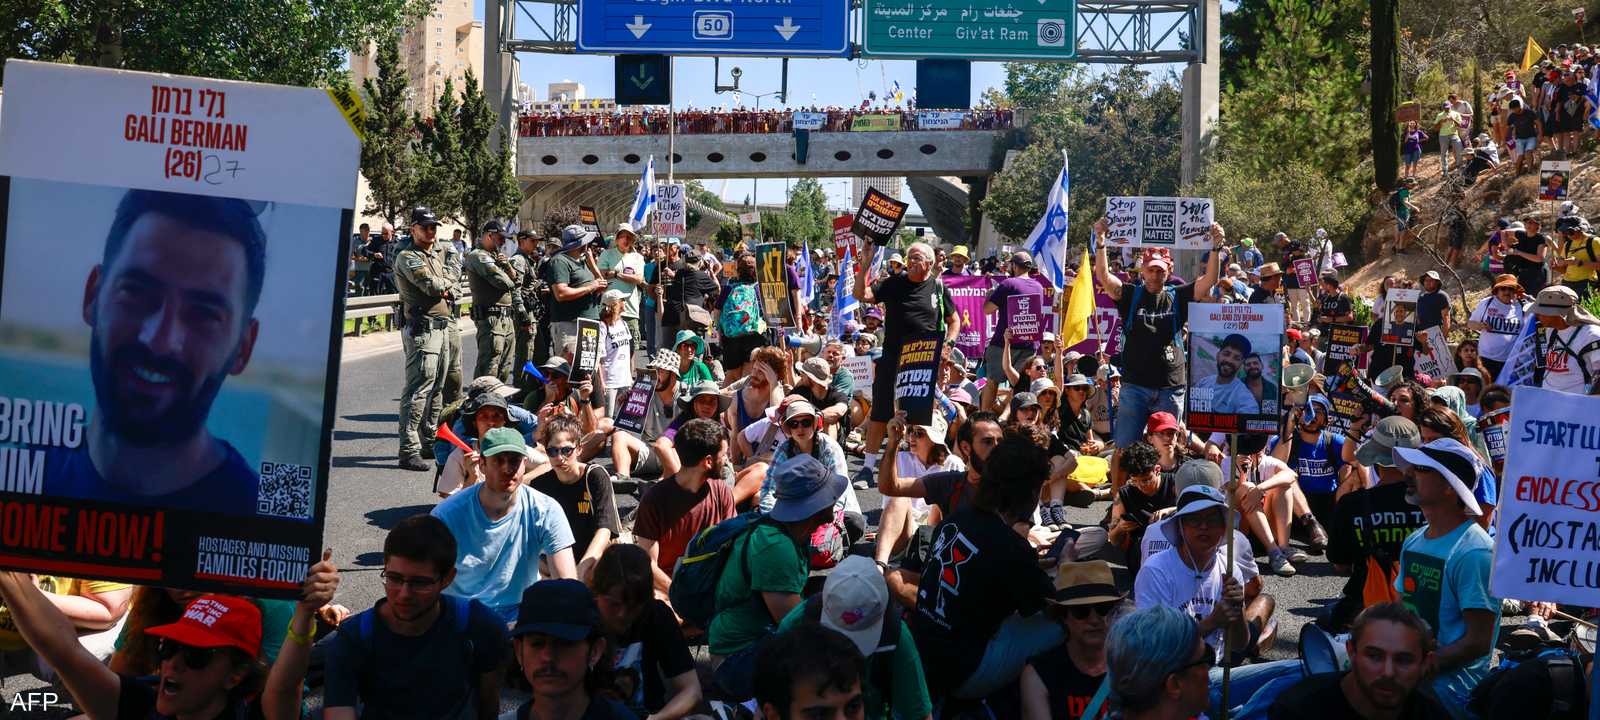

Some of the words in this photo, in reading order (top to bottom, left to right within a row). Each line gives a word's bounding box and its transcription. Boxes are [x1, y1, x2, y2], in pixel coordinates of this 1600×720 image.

[874, 3, 914, 19] المدينة
[703, 19, 723, 31] 50
[888, 25, 933, 39] Center
[956, 26, 994, 39] Giv'at
[1000, 28, 1029, 40] Ram
[152, 85, 192, 115] ברמן
[199, 88, 225, 118] גלי
[124, 114, 166, 144] GALI
[170, 118, 248, 152] BERMAN
[165, 147, 202, 182] (26)
[204, 154, 246, 185] 27
[658, 185, 679, 198] END
[653, 210, 680, 222] STOP
[1145, 214, 1174, 227] LIVES
[1144, 231, 1174, 240] MATTER
[1190, 387, 1214, 400] BRING
[1190, 400, 1212, 412] THEM
[0, 397, 84, 449] BRING
[1353, 511, 1407, 531] החטף
[0, 501, 70, 551] OME
[75, 509, 165, 563] NOW!
[198, 536, 247, 556] HOSTAGES
[247, 541, 267, 558] AND
[268, 544, 310, 562] MISSING
[197, 552, 258, 579] FAMILIES
[260, 559, 309, 584] FORUM
[184, 609, 218, 627] WAR
